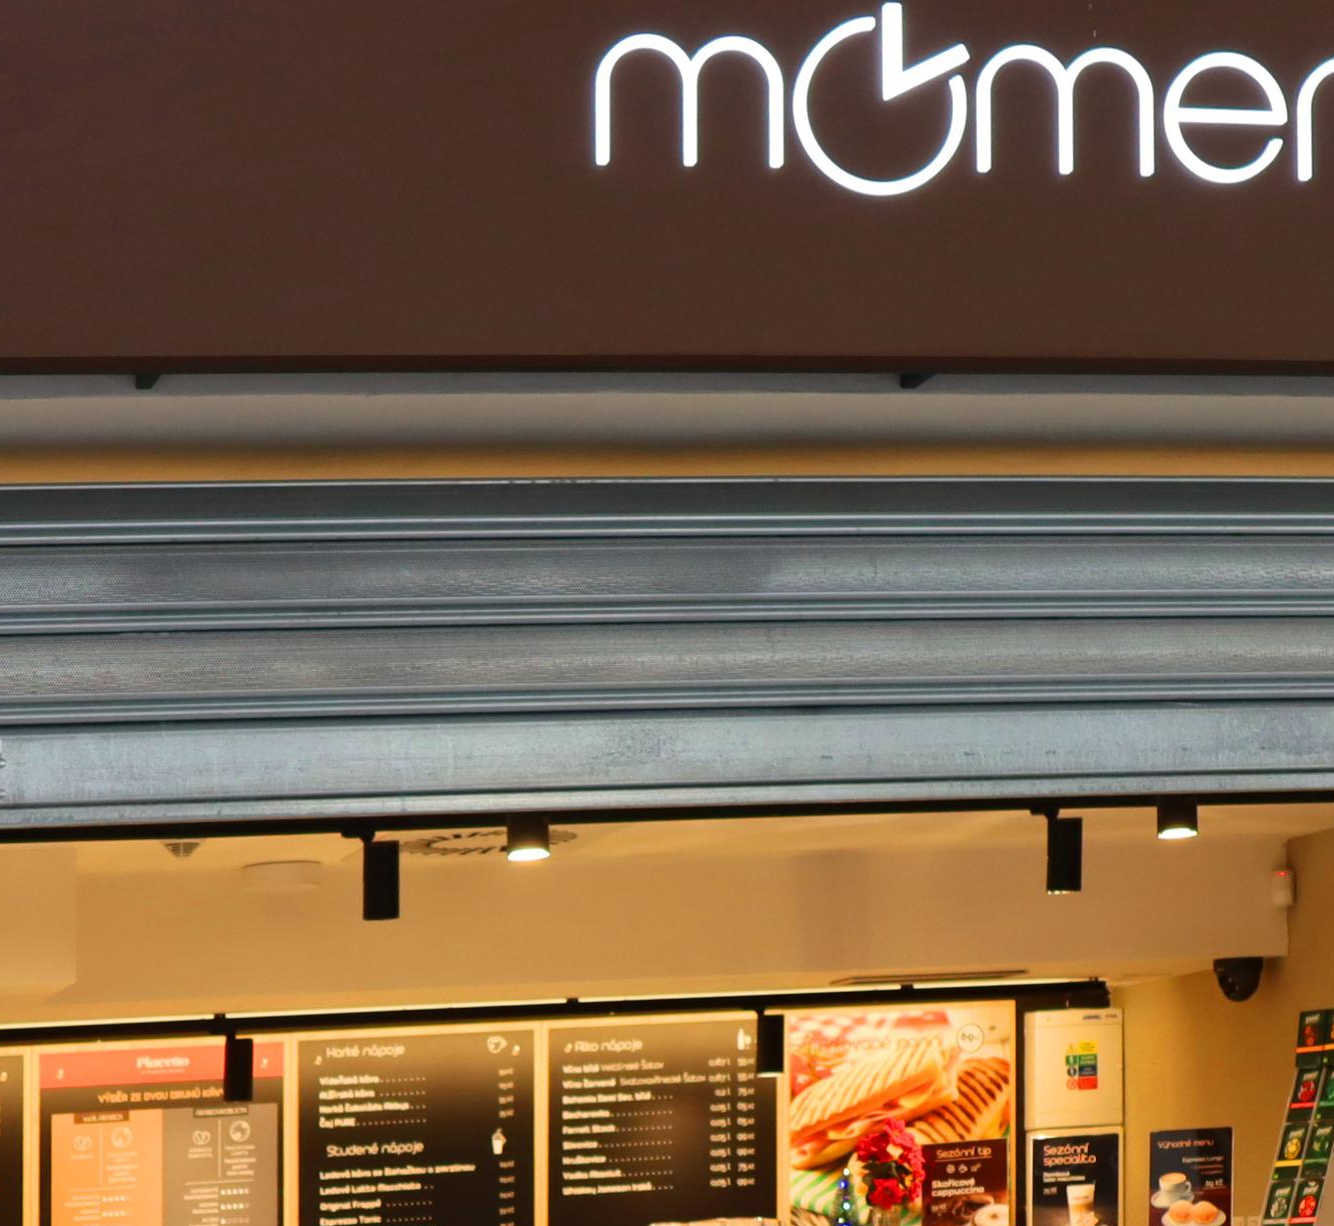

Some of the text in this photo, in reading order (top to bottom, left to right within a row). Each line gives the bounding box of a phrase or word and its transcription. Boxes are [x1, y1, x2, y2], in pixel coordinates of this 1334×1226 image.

[326, 1044, 406, 1059] Horké nápoje
[574, 1039, 643, 1053] Alko nápoje
[319, 1117, 334, 1129] Čaj
[326, 1141, 425, 1158] Studené nápoje
[936, 1145, 993, 1160] Sezónní tip
[1043, 1142, 1091, 1157] Sezónní
[1043, 1153, 1097, 1167] specialita
[351, 1184, 376, 1194] Latte
[931, 1177, 976, 1189] Skořicové
[931, 1186, 985, 1198] cappuccino
[319, 1198, 382, 1212] Original Frappé
[319, 1218, 358, 1226] Espresso
